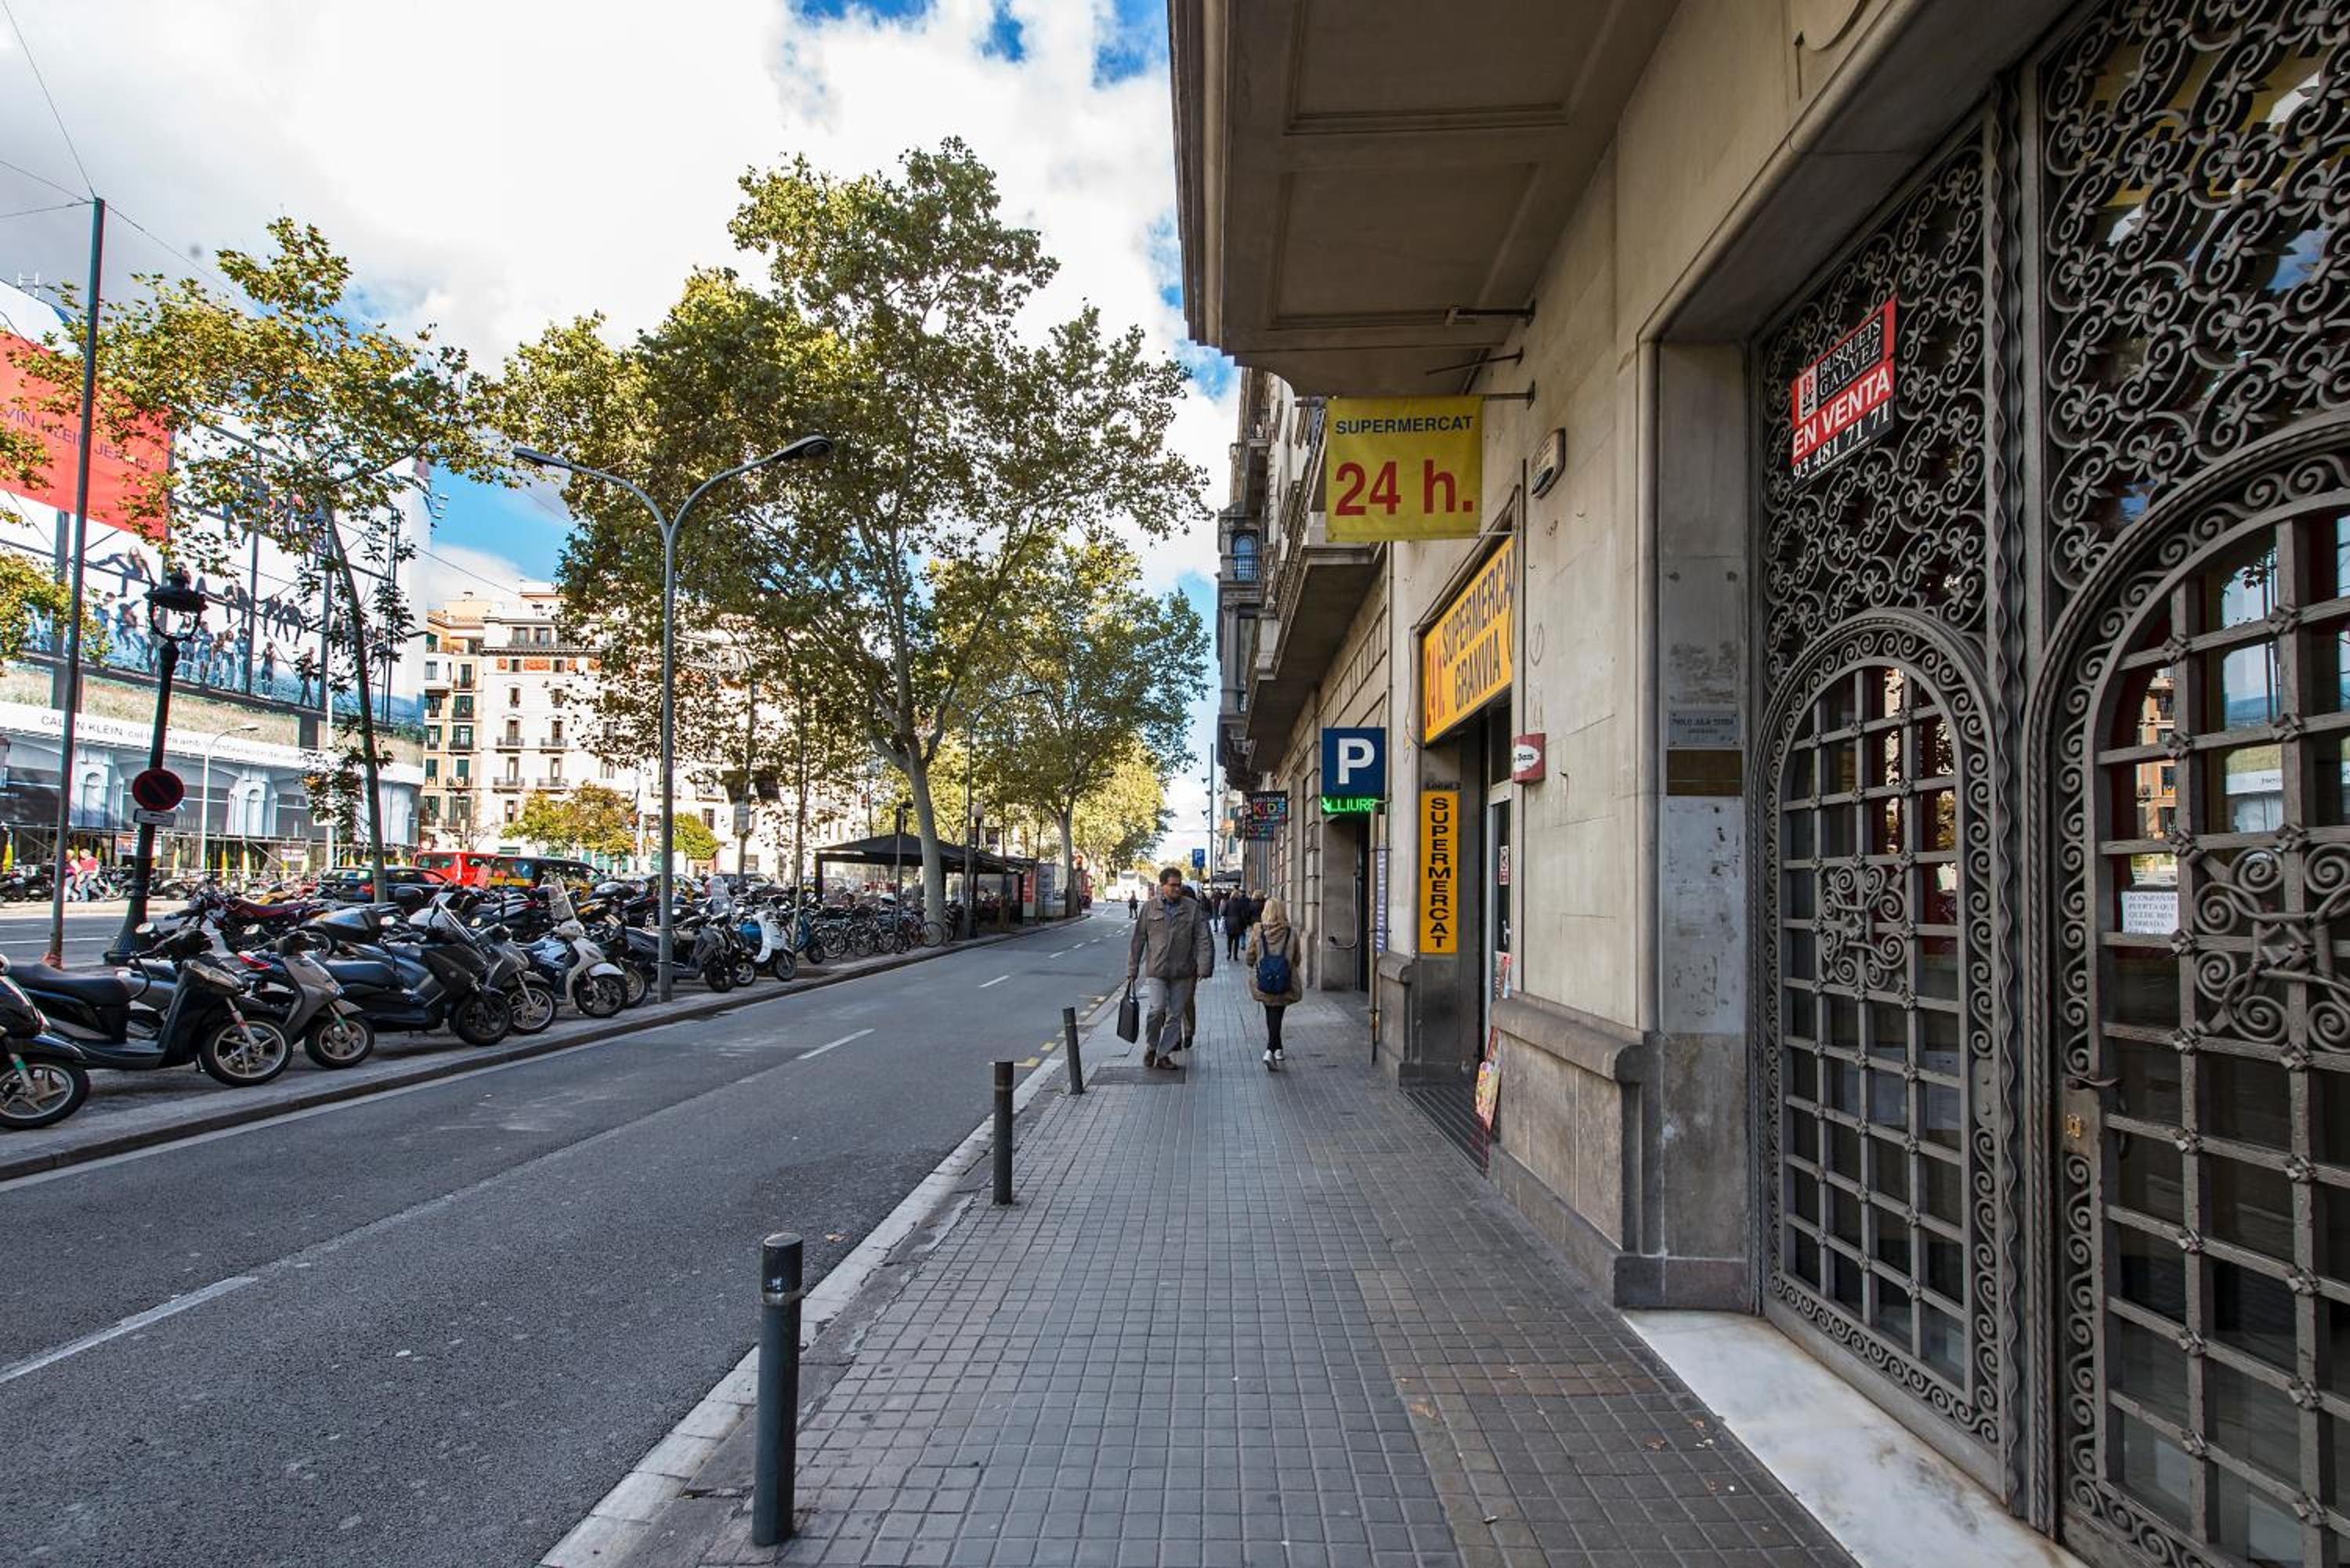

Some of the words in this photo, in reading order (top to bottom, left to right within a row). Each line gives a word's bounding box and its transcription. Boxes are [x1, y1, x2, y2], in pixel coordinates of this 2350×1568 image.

[1820, 316, 1881, 378] BUSQUETS
[1820, 338, 1881, 396] GALVEZ
[1336, 415, 1473, 435] SUPERMERCAT
[1793, 418, 1817, 458] EN
[1822, 367, 1891, 434] VENTA
[1793, 457, 1809, 484] 93
[1813, 435, 1838, 468] 481
[1846, 419, 1863, 446] 71
[1871, 400, 1889, 429] 71
[1335, 461, 1401, 516] 24
[1423, 459, 1473, 515] h.
[1442, 551, 1513, 668] SUPERMERCA
[1455, 629, 1501, 711] GRANVIA
[42, 715, 85, 731] CALN
[89, 723, 123, 735] KLEIN
[1339, 738, 1375, 784] P
[1253, 802, 1285, 815] KIDS
[1195, 851, 1203, 861] P
[1428, 797, 1451, 948] SUPERMERCAT
